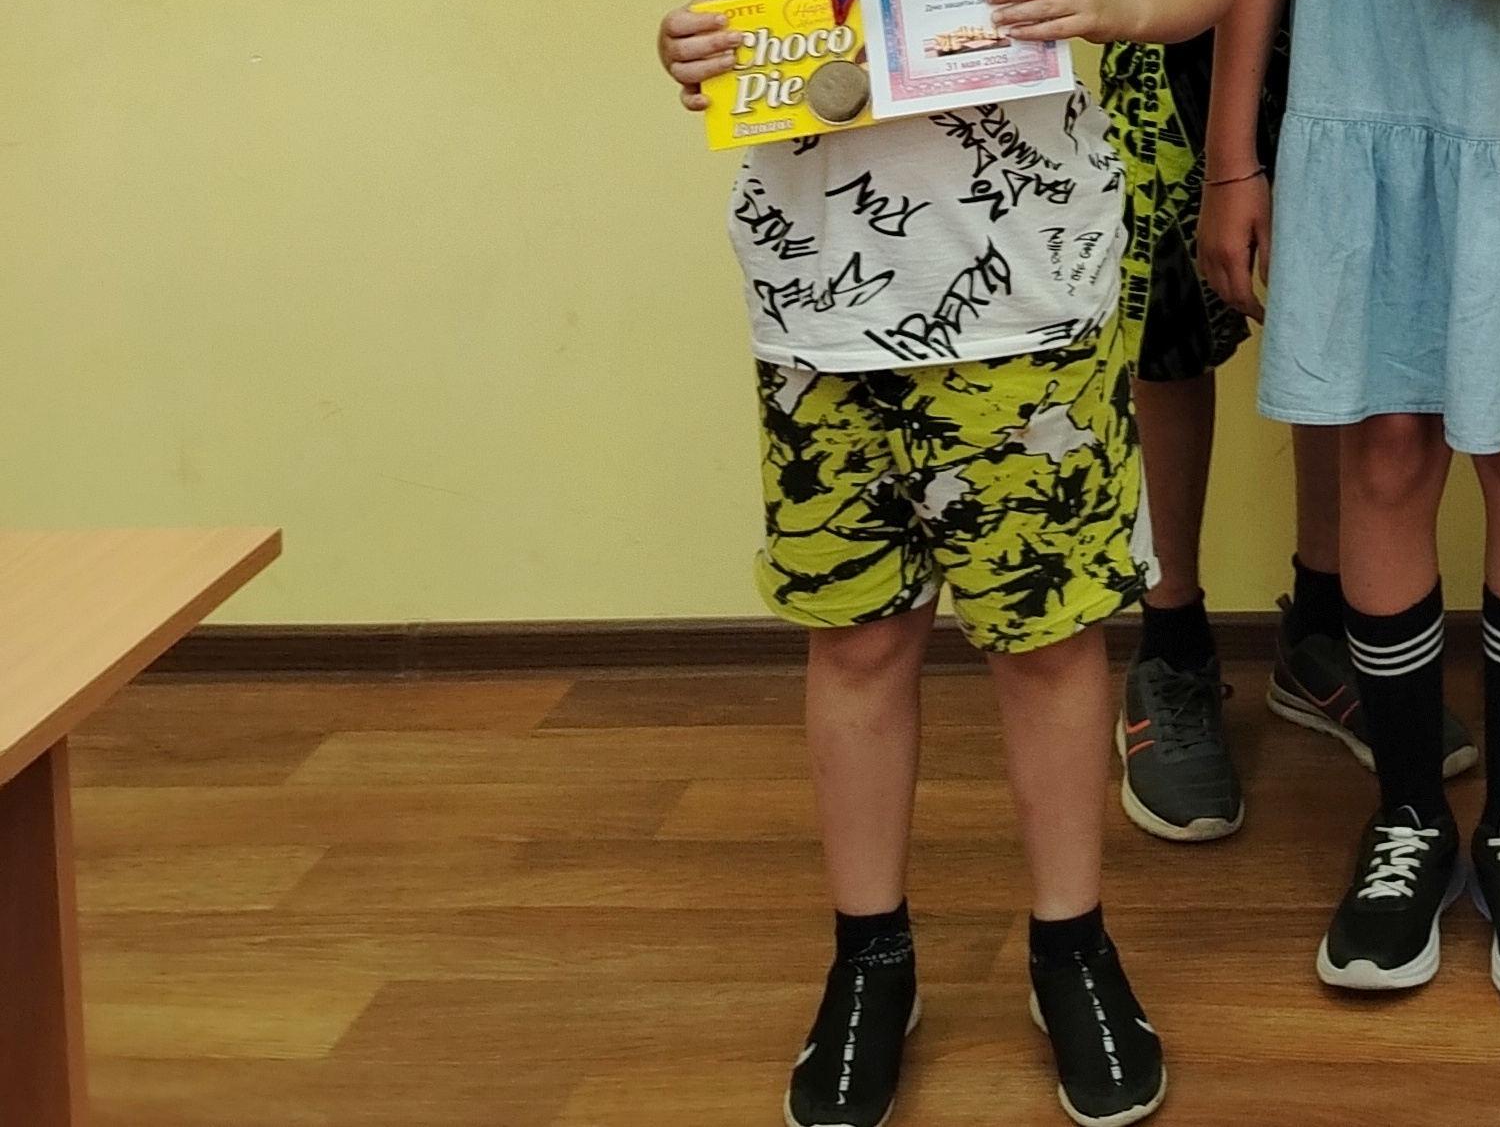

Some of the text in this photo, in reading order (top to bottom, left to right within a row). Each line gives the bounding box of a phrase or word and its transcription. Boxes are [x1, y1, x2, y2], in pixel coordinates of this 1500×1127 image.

[724, 3, 767, 20] OTTE
[945, 54, 1009, 72] 31 мая 2025
[1142, 47, 1162, 114] CROSS
[730, 70, 805, 116] Pie
[1125, 275, 1150, 322] MEN
